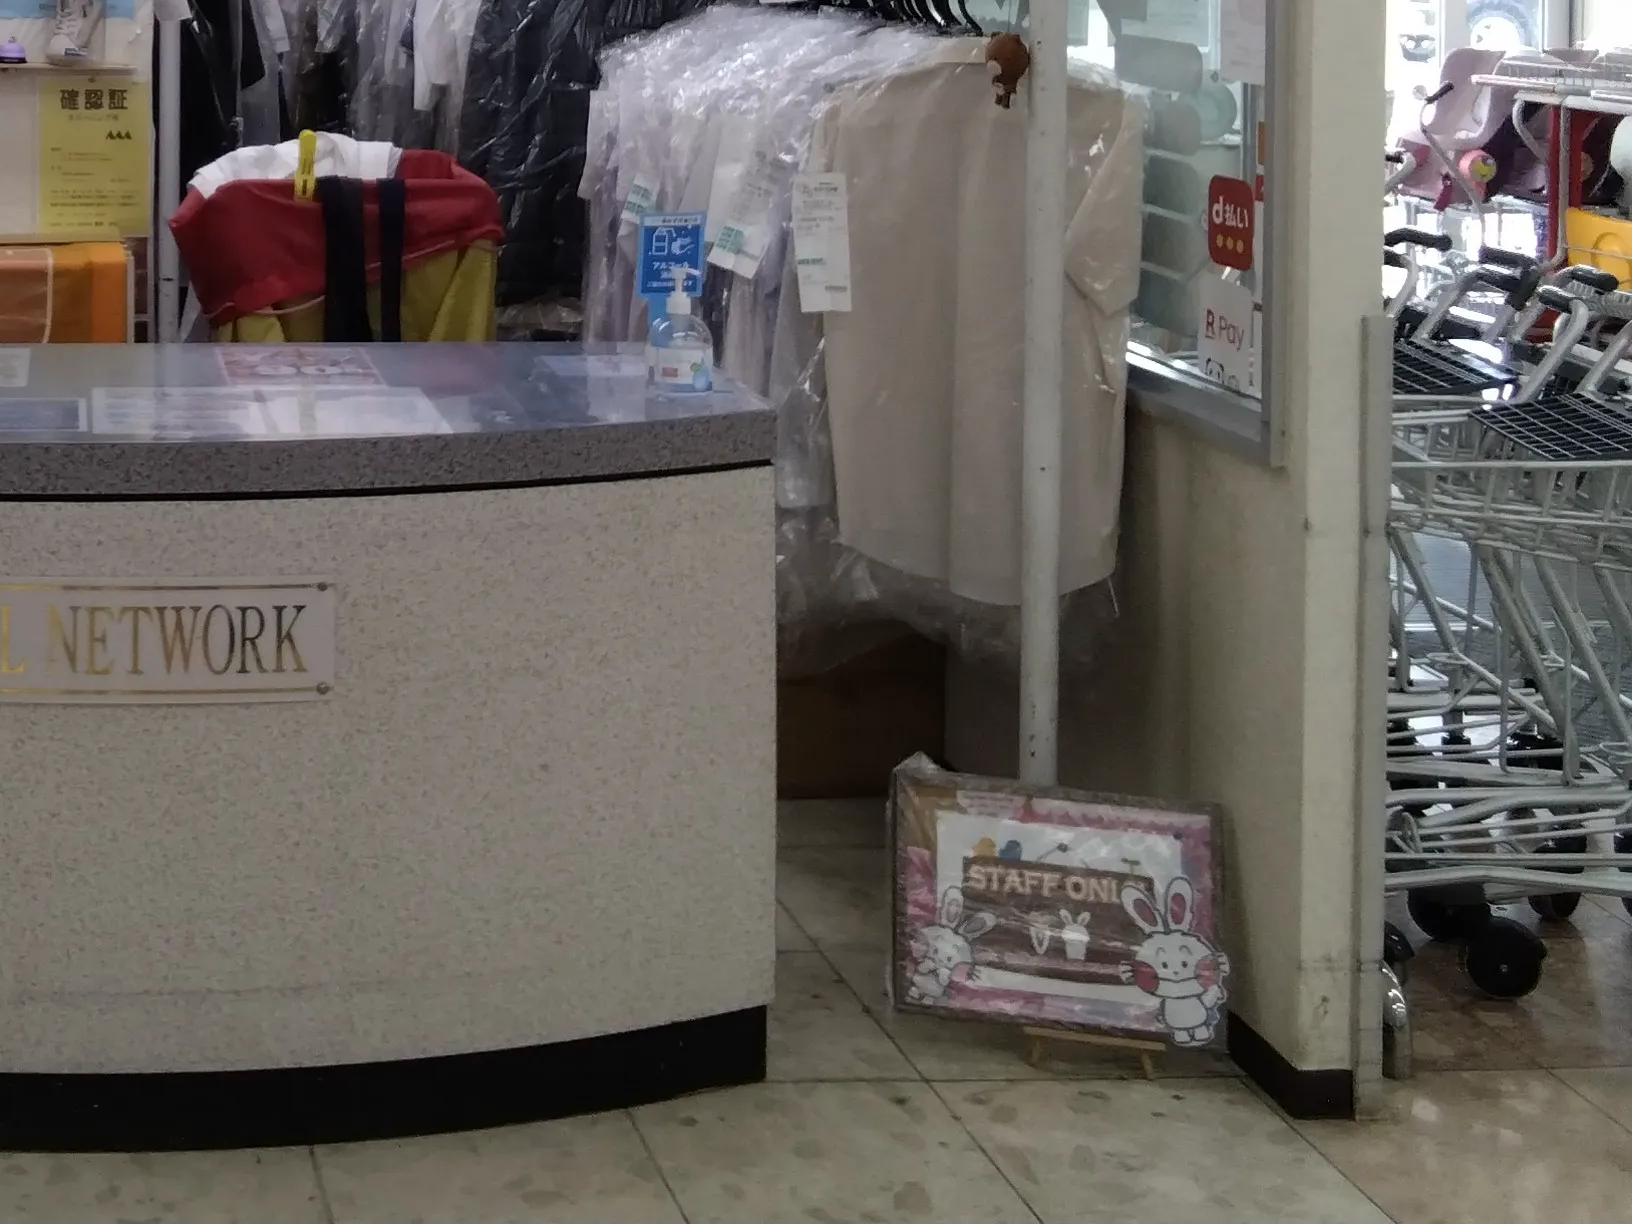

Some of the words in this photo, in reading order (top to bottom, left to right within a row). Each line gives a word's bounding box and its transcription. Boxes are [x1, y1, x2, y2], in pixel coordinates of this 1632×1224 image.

[59, 88, 129, 110] 確認証
[1211, 196, 1249, 229] d払い
[46, 604, 308, 676] NETWORK
[966, 864, 1060, 898] STAFF
[1067, 877, 1121, 904] ONL
